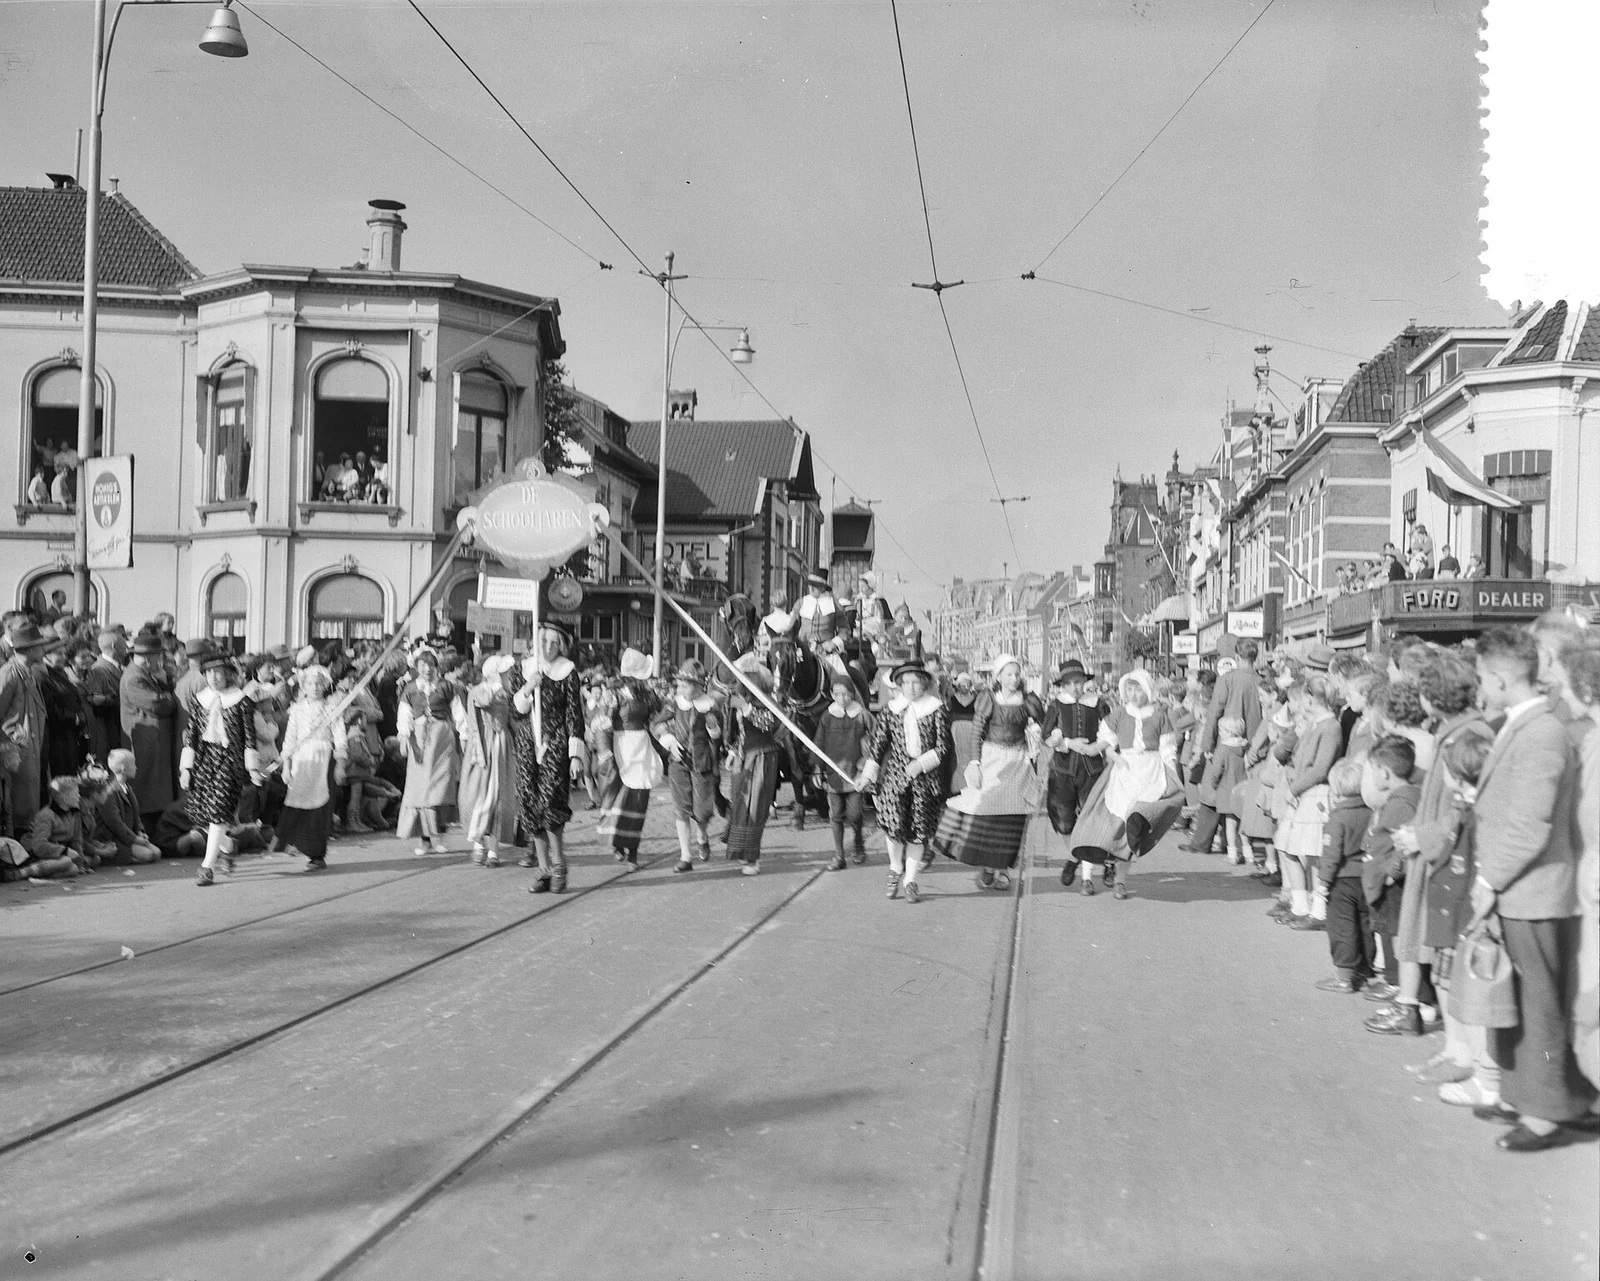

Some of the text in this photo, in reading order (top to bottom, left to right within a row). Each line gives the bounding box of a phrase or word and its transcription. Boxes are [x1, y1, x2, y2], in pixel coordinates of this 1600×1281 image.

[521, 486, 537, 504] DE
[483, 508, 583, 532] SCHOOLJAREN
[642, 541, 720, 561] HOTEL
[1402, 589, 1545, 610] FORD DEALER
